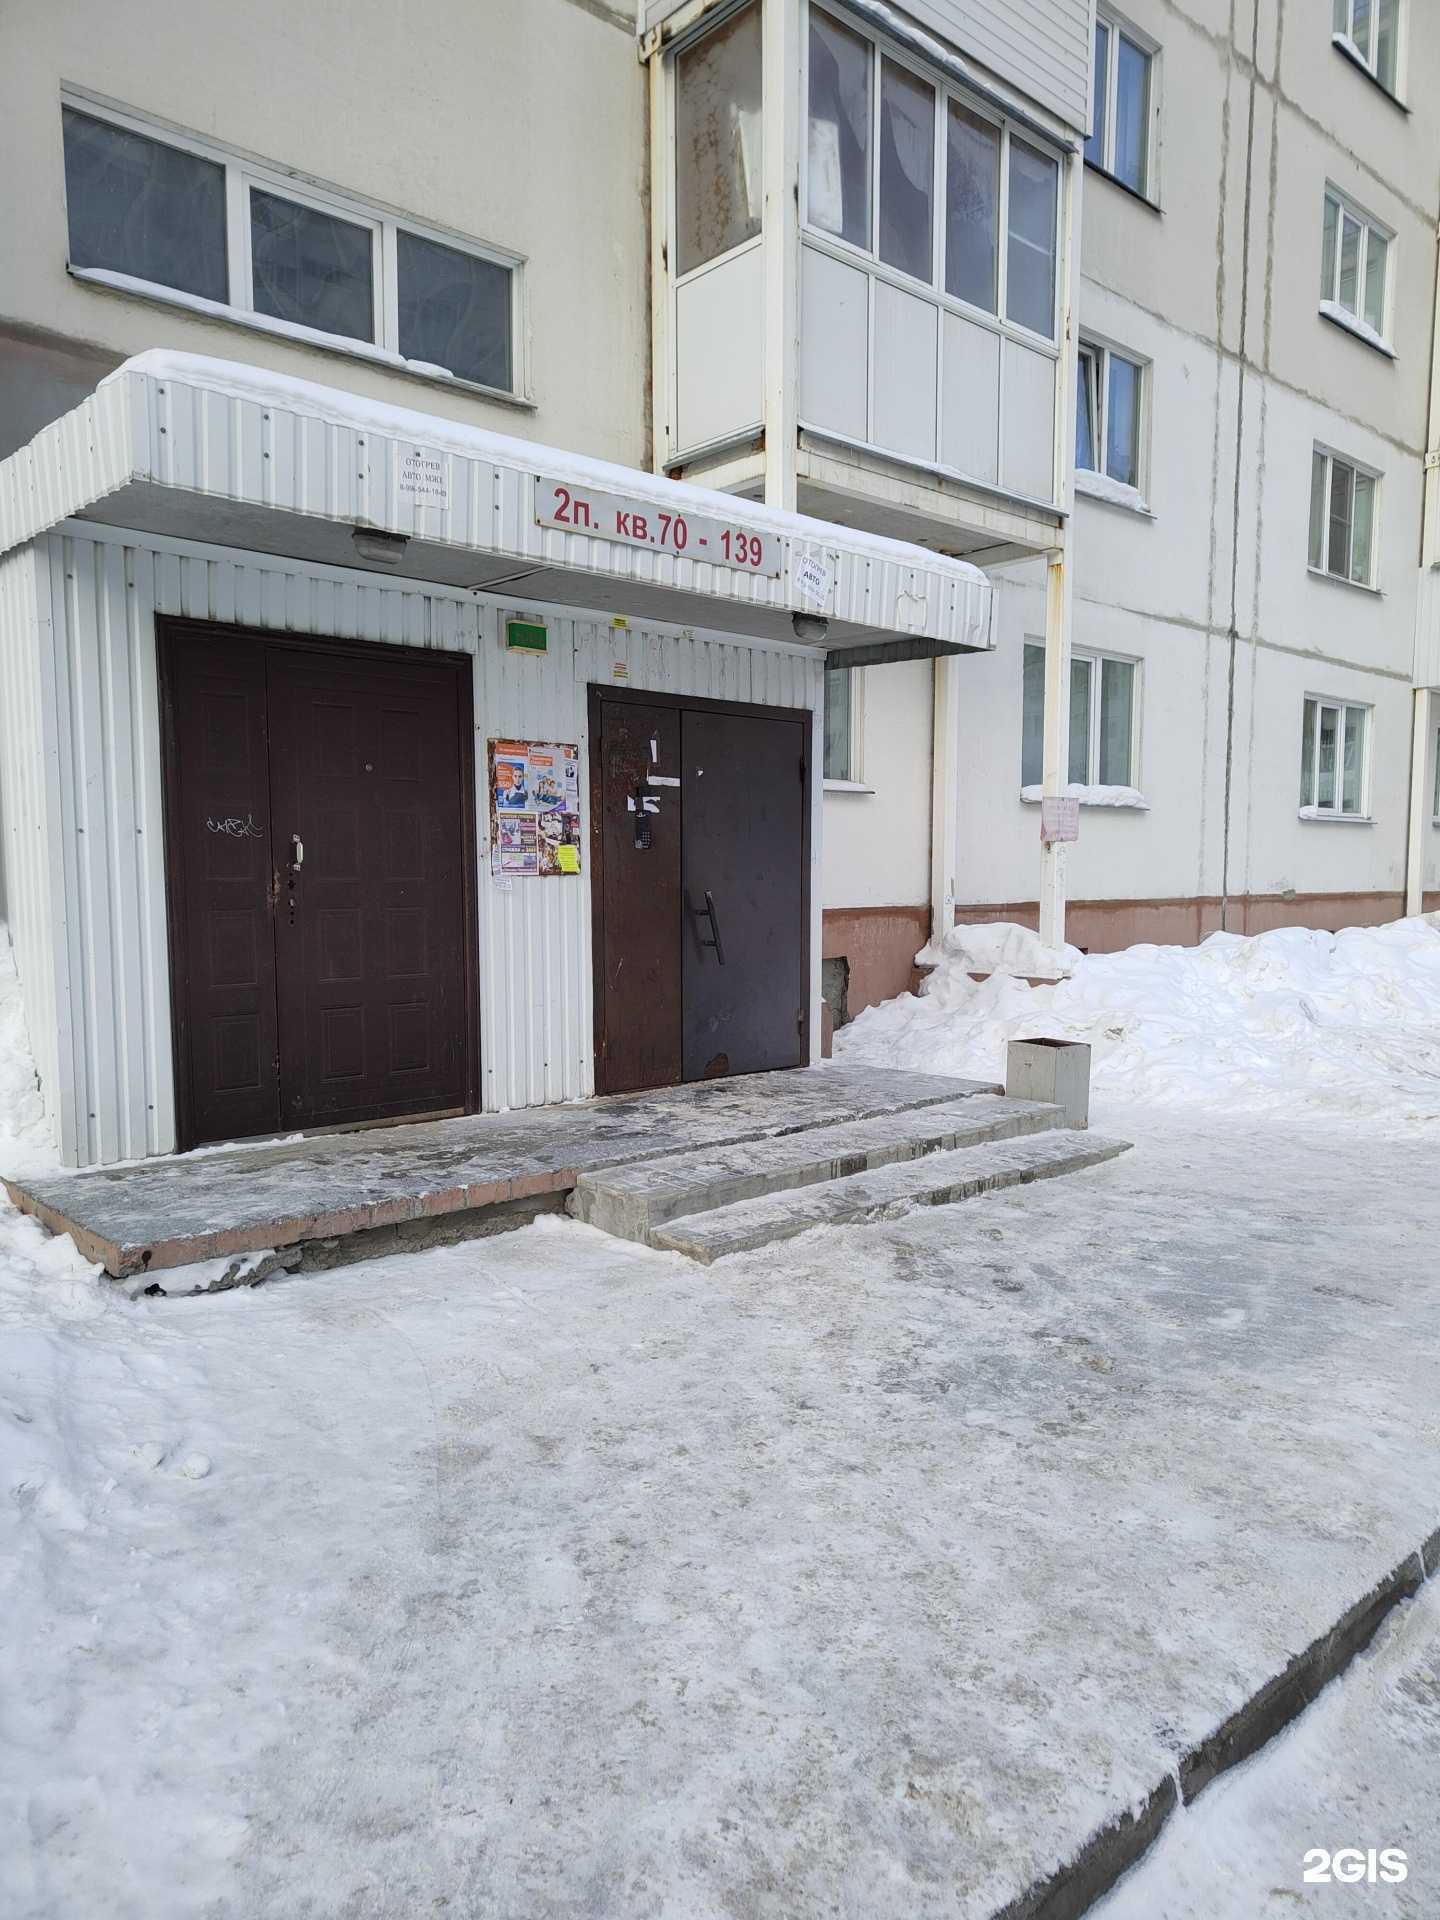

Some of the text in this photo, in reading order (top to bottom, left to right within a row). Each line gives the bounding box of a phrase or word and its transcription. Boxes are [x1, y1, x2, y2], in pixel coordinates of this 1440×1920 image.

[554, 487, 599, 529] 2п.
[720, 529, 762, 566] 139
[803, 571, 820, 585] АВТО
